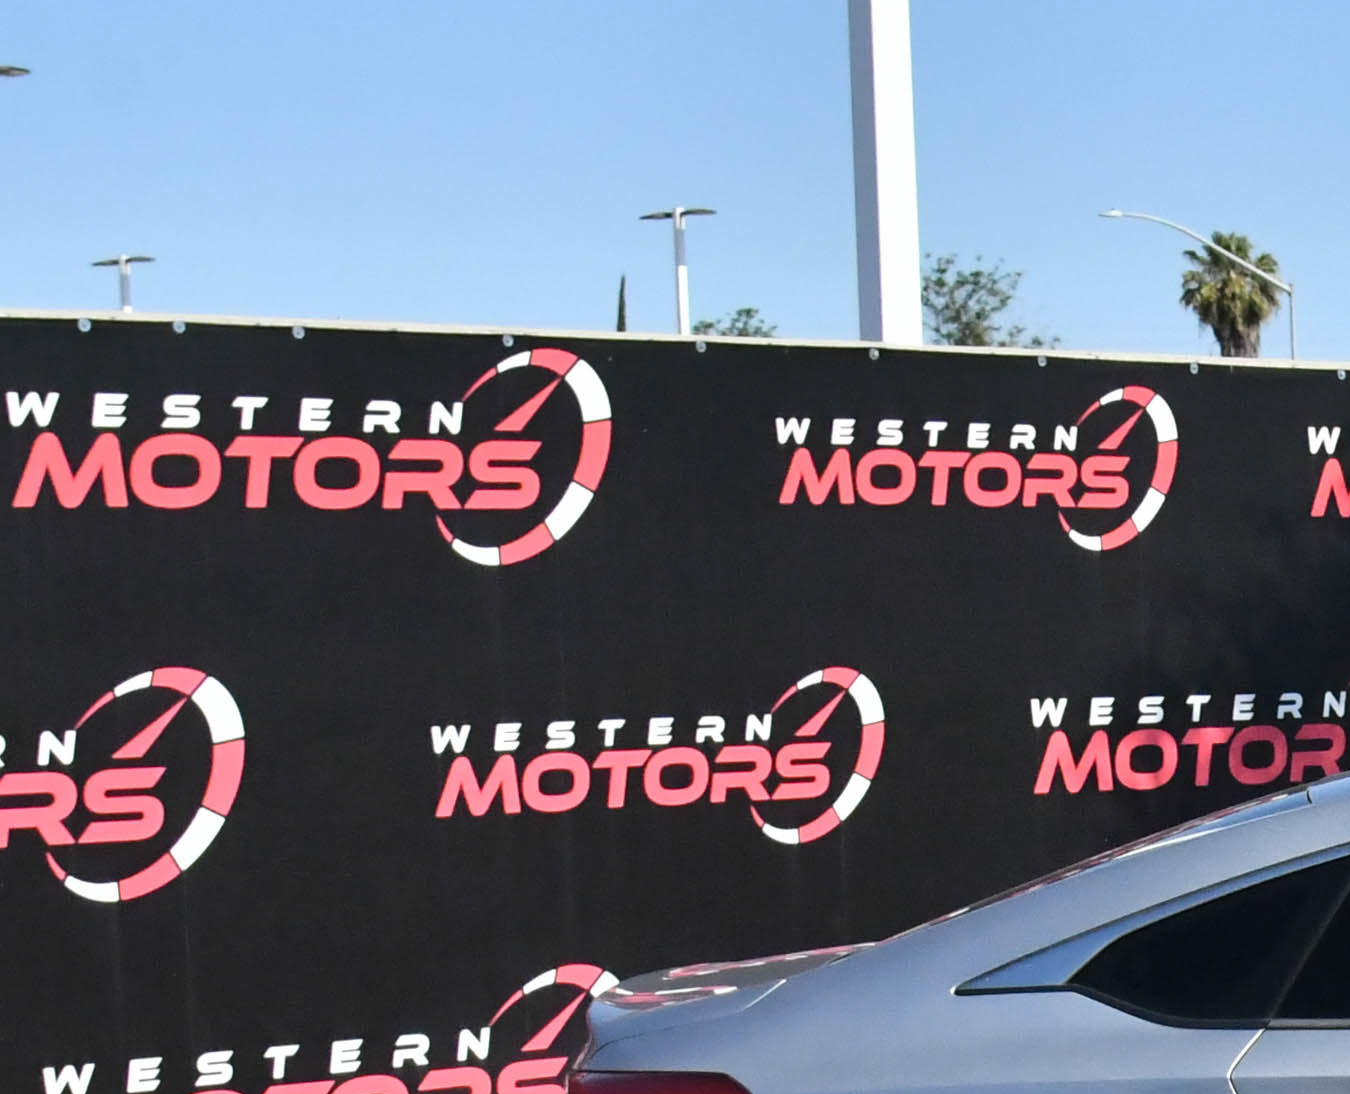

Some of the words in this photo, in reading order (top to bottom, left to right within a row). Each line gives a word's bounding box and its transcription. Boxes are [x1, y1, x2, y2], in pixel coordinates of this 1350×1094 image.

[6, 392, 463, 434] WESTERN
[776, 417, 1077, 450] WESTERN
[13, 432, 542, 510] MOTORS
[779, 448, 1130, 508] MOTORS
[1031, 691, 1346, 727] WESTERN
[431, 715, 772, 753] WESTERN
[435, 745, 831, 818] MOTORS
